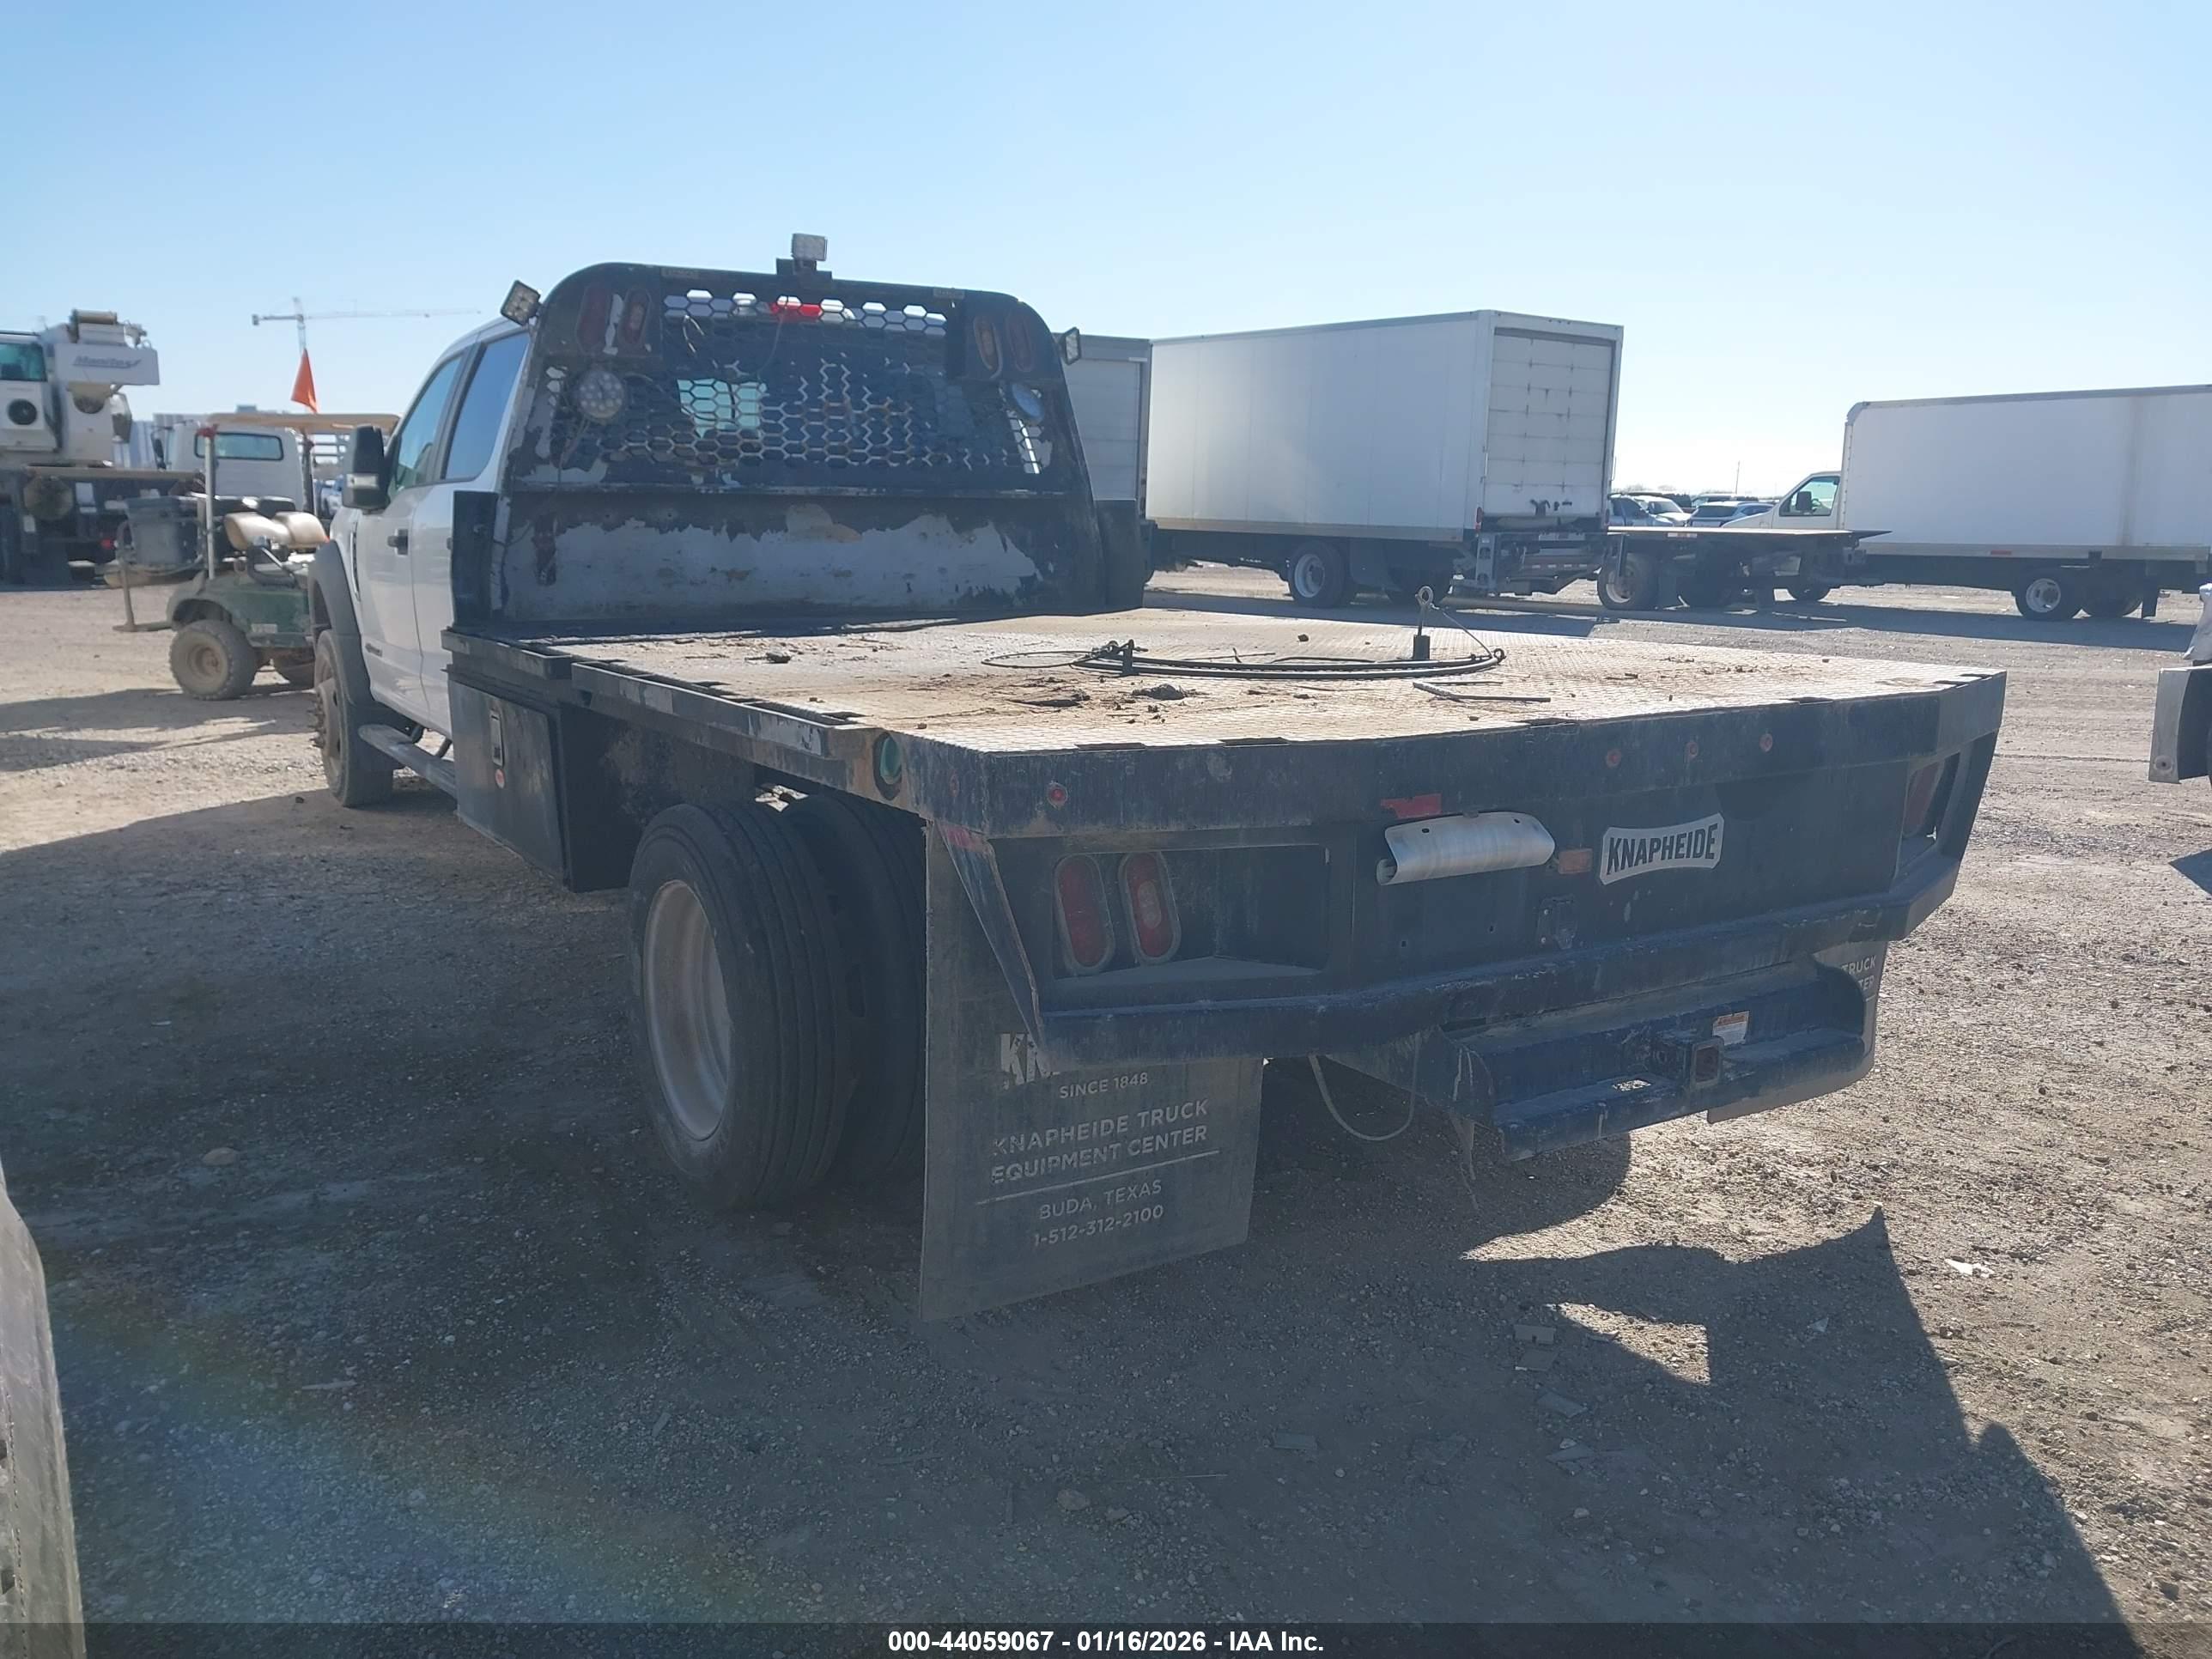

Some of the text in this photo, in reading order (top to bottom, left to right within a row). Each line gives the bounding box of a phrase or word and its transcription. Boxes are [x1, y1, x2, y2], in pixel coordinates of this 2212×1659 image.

[1607, 823, 1718, 876] KNAPHEIDE
[1059, 1072, 1149, 1099] SINCE 1848
[992, 1099, 1209, 1156] KNAPHEIDE TRUCK
[990, 1125, 1207, 1184] EQUIPMENT CENTER
[1039, 1179, 1163, 1219] BUDA, TEXAS
[1034, 1204, 1164, 1247] 1-512-312-2100
